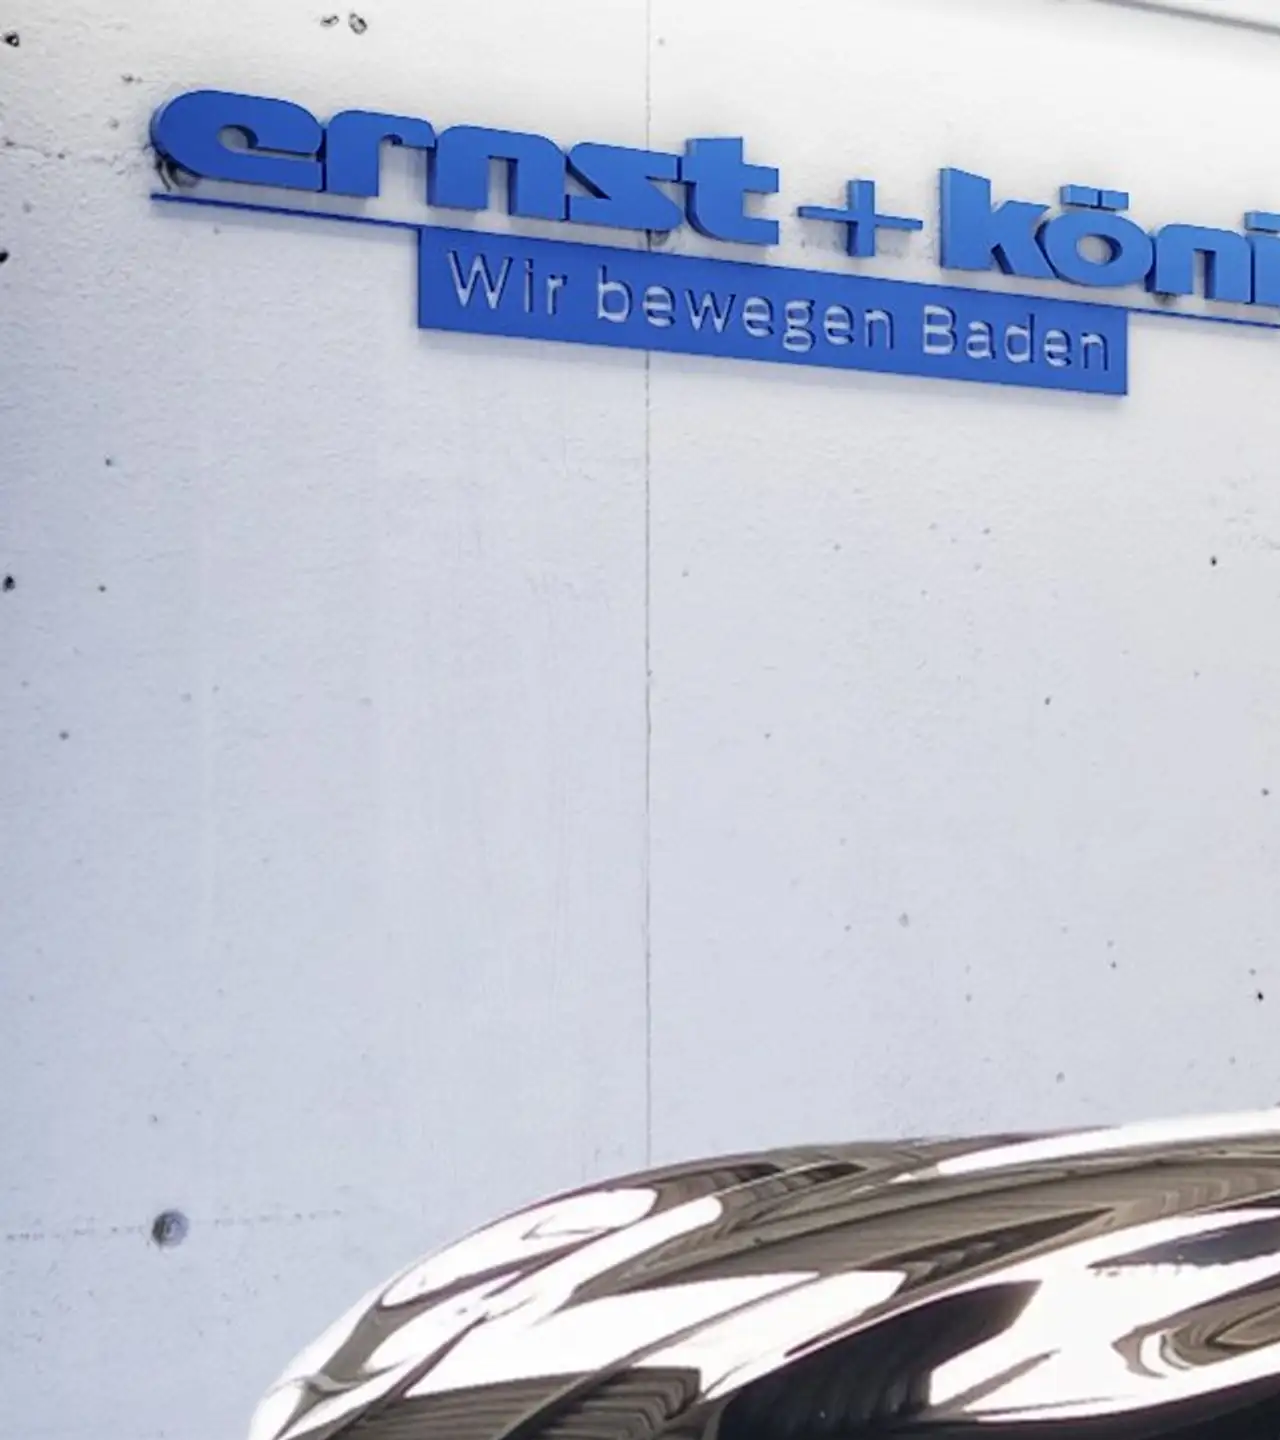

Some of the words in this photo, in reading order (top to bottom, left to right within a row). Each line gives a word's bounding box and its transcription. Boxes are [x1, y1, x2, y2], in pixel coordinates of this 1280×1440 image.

[449, 249, 569, 315] Wir
[597, 264, 895, 354] bewegen
[922, 304, 1110, 371] Baden
